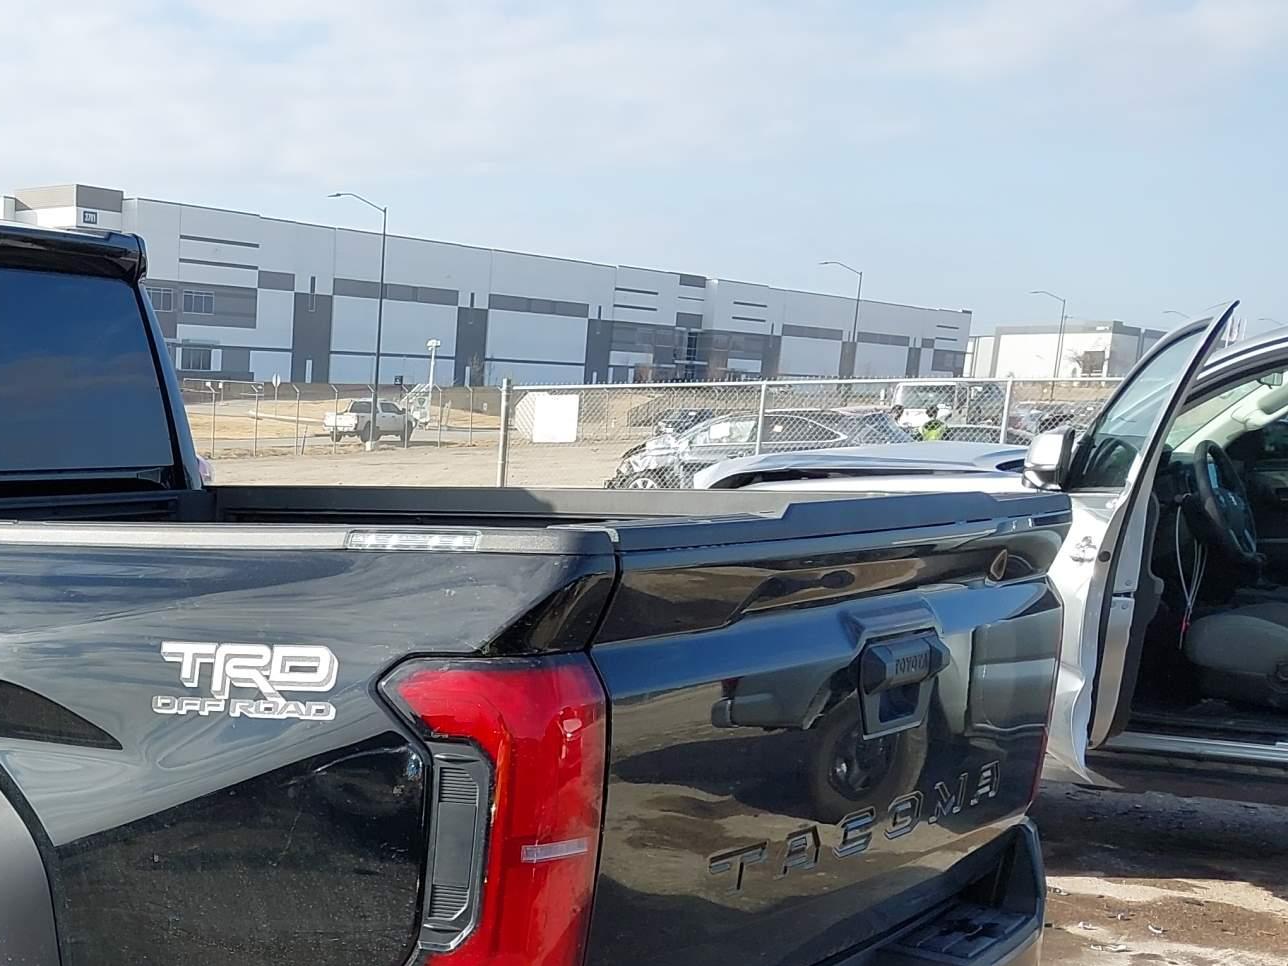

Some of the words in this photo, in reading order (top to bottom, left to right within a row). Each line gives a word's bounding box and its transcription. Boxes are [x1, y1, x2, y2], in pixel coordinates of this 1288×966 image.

[160, 641, 339, 701] TRD
[151, 695, 226, 716] OFF
[228, 699, 337, 722] ROAD
[708, 759, 1001, 896] TACOMA
